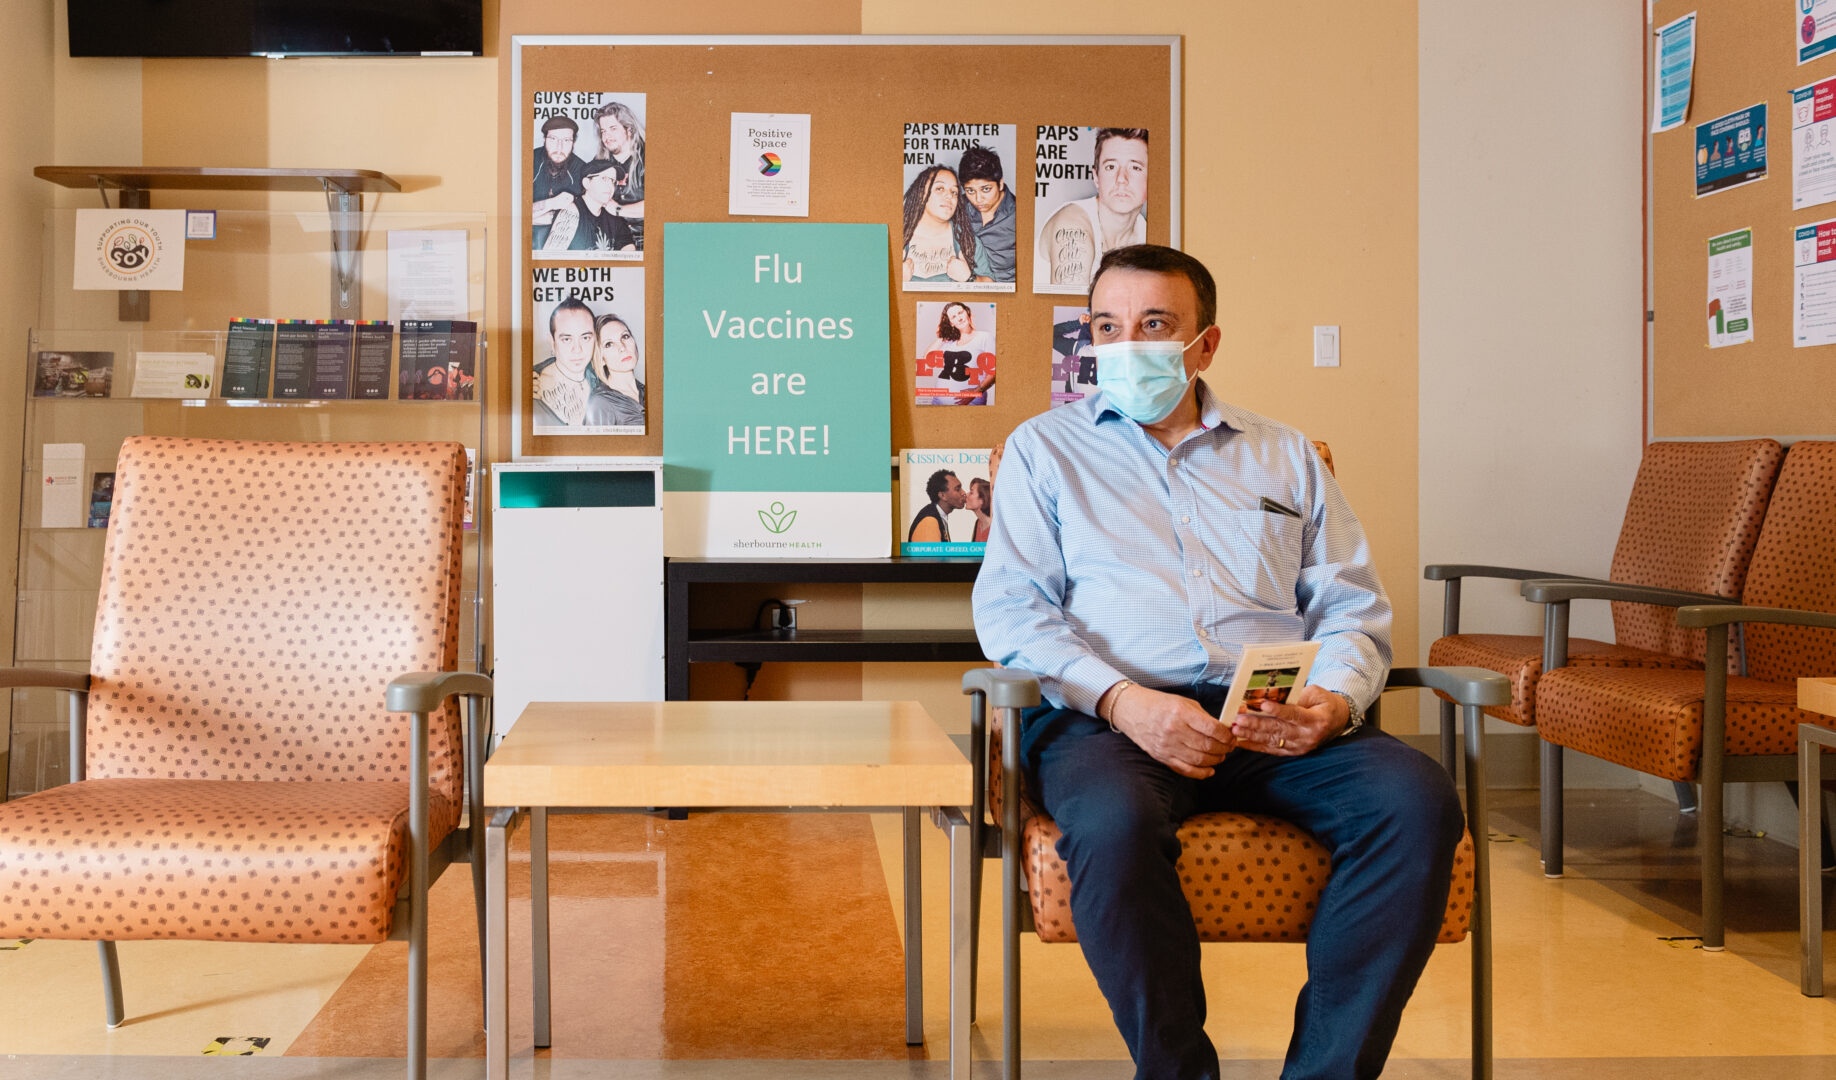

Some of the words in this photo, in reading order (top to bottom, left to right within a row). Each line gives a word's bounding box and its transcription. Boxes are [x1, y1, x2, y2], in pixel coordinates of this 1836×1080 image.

[533, 92, 571, 105] GUYS
[577, 92, 604, 105] GET
[533, 107, 568, 120] PAPS
[748, 128, 793, 138] Positive
[903, 123, 939, 136] PAPS
[944, 123, 999, 136] MATTER
[1036, 125, 1079, 142] PAPS
[752, 138, 787, 149] Space
[903, 138, 929, 150] FOR
[933, 138, 980, 151] TRANS
[903, 152, 935, 165] MEN
[1036, 144, 1068, 160] ARE
[1035, 163, 1094, 180] WORTH
[1035, 182, 1050, 197] IT
[97, 219, 131, 251] SUPPORTING
[134, 219, 149, 229] OUR
[150, 228, 163, 251] YOUTH
[113, 248, 147, 266] SOY
[140, 257, 161, 279] HEALTH
[533, 267, 560, 283] WE
[566, 267, 611, 282] BOTH
[753, 253, 802, 284] Flu
[533, 287, 564, 302] GET
[570, 286, 614, 302] PAPS
[702, 309, 854, 340] Vaccines
[751, 371, 806, 396] are
[728, 425, 830, 455] HERE!
[906, 452, 954, 464] KISSING
[733, 539, 788, 549] sherbourne
